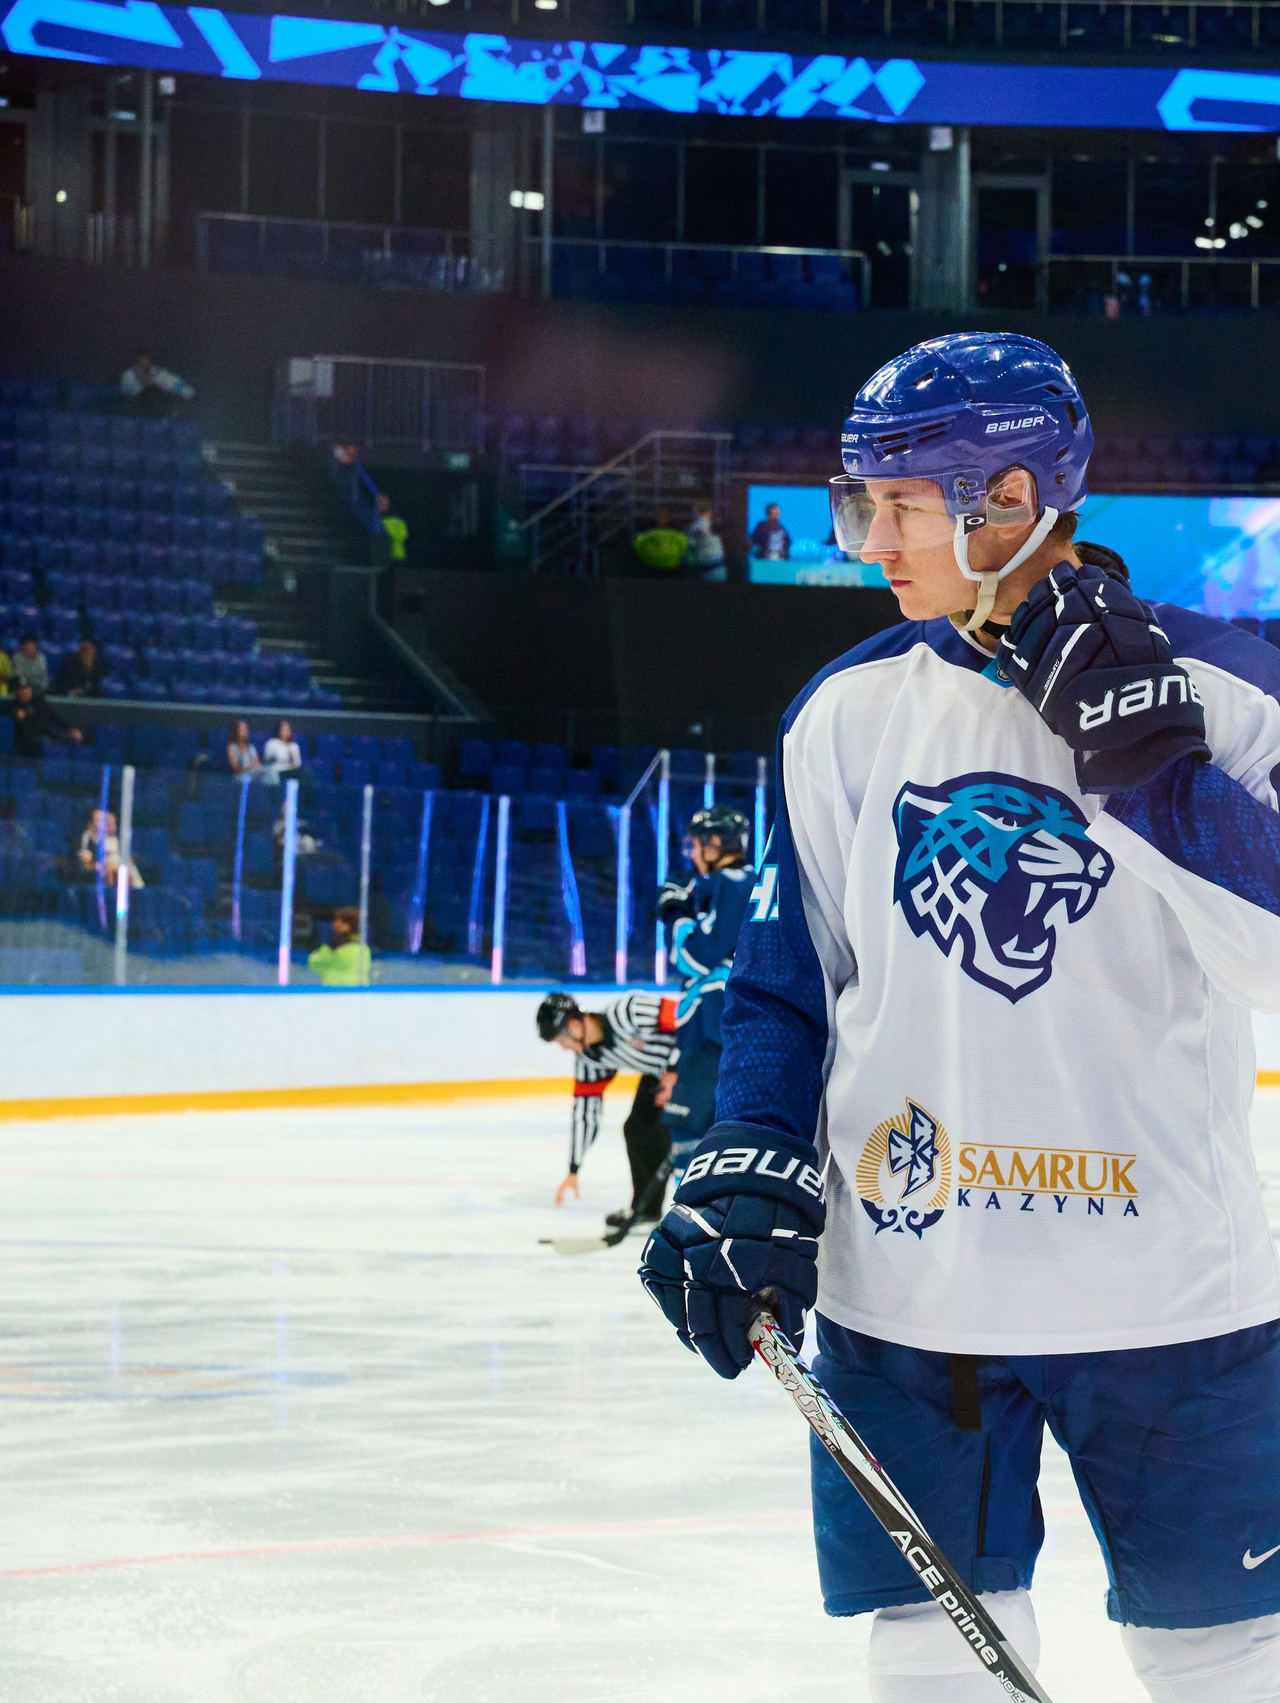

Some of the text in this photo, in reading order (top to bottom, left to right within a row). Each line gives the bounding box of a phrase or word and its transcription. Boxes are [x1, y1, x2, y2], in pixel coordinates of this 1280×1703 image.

[985, 415, 1045, 434] BAUER
[957, 1146, 1138, 1193] SAMRUK
[957, 1188, 1139, 1217] KAZYNA
[889, 1530, 945, 1590] ACE
[935, 1589, 999, 1666] prime
